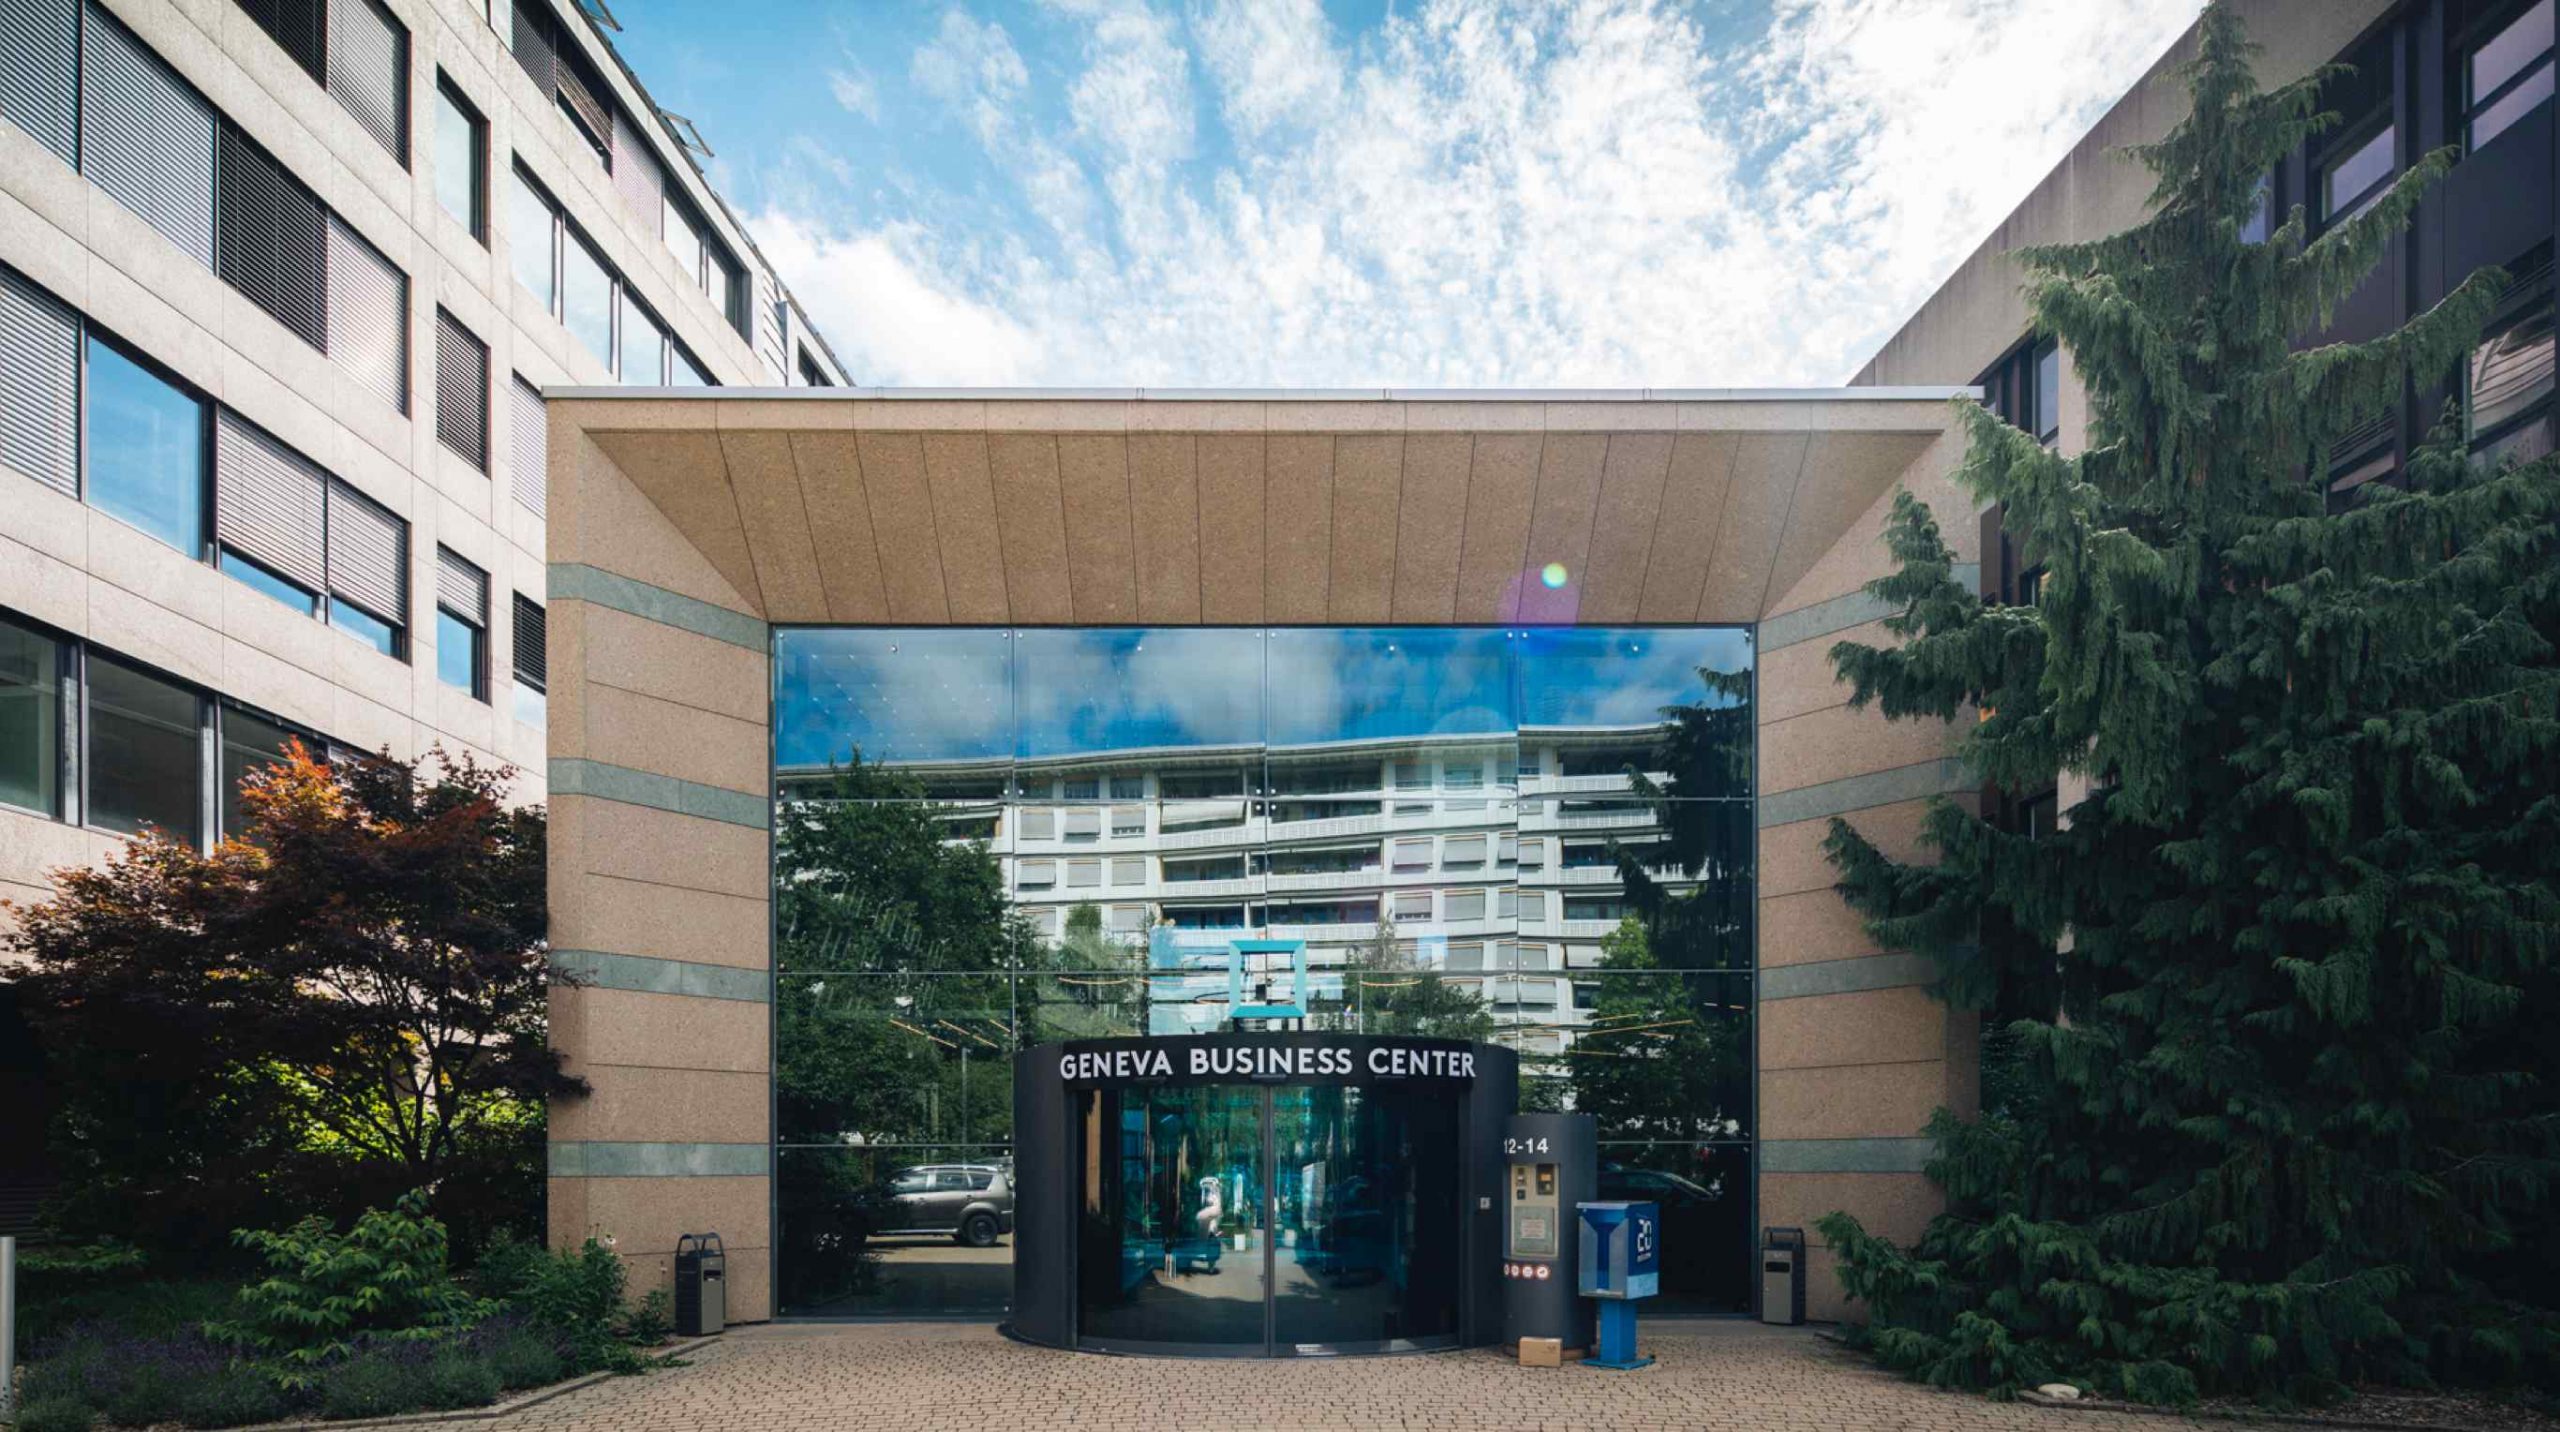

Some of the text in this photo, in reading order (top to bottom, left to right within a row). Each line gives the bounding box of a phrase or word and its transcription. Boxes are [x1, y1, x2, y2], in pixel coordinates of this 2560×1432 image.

[1060, 1048, 1476, 1079] GENEVA BUSINESS CENTER
[1503, 1137, 1549, 1154] 12-14
